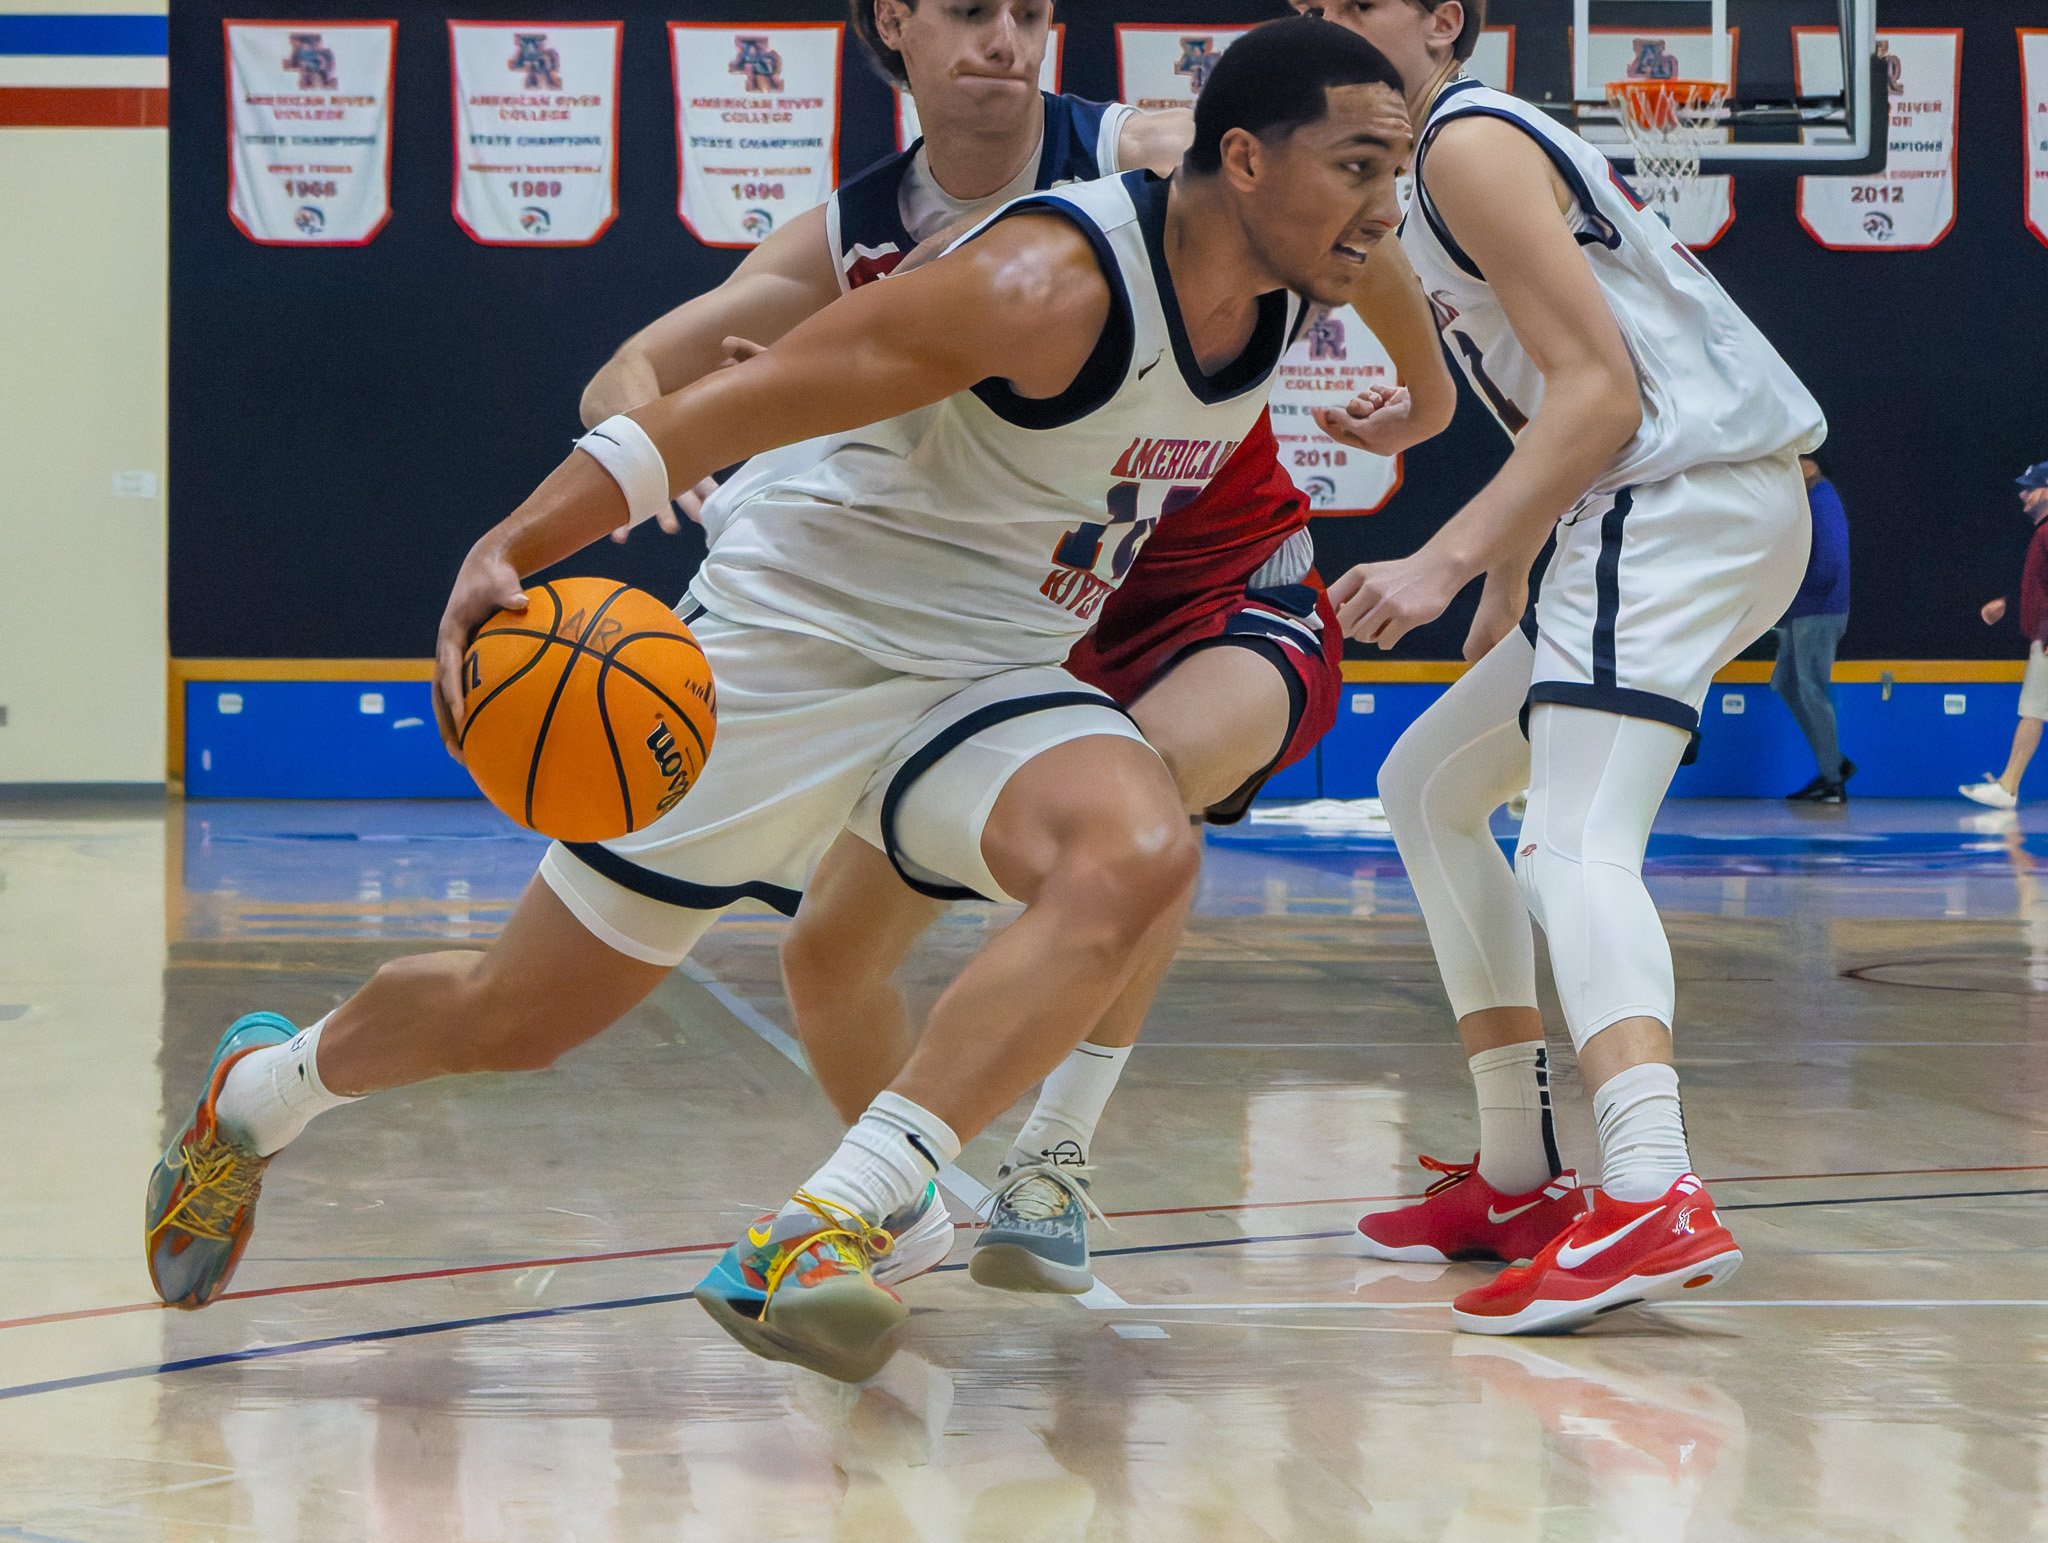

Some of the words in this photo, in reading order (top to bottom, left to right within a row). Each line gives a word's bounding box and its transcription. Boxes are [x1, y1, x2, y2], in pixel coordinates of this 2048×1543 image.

[1897, 101, 1943, 113] RIVER
[1851, 186, 1905, 204] 2012
[1285, 378, 1355, 391] COLLEGE
